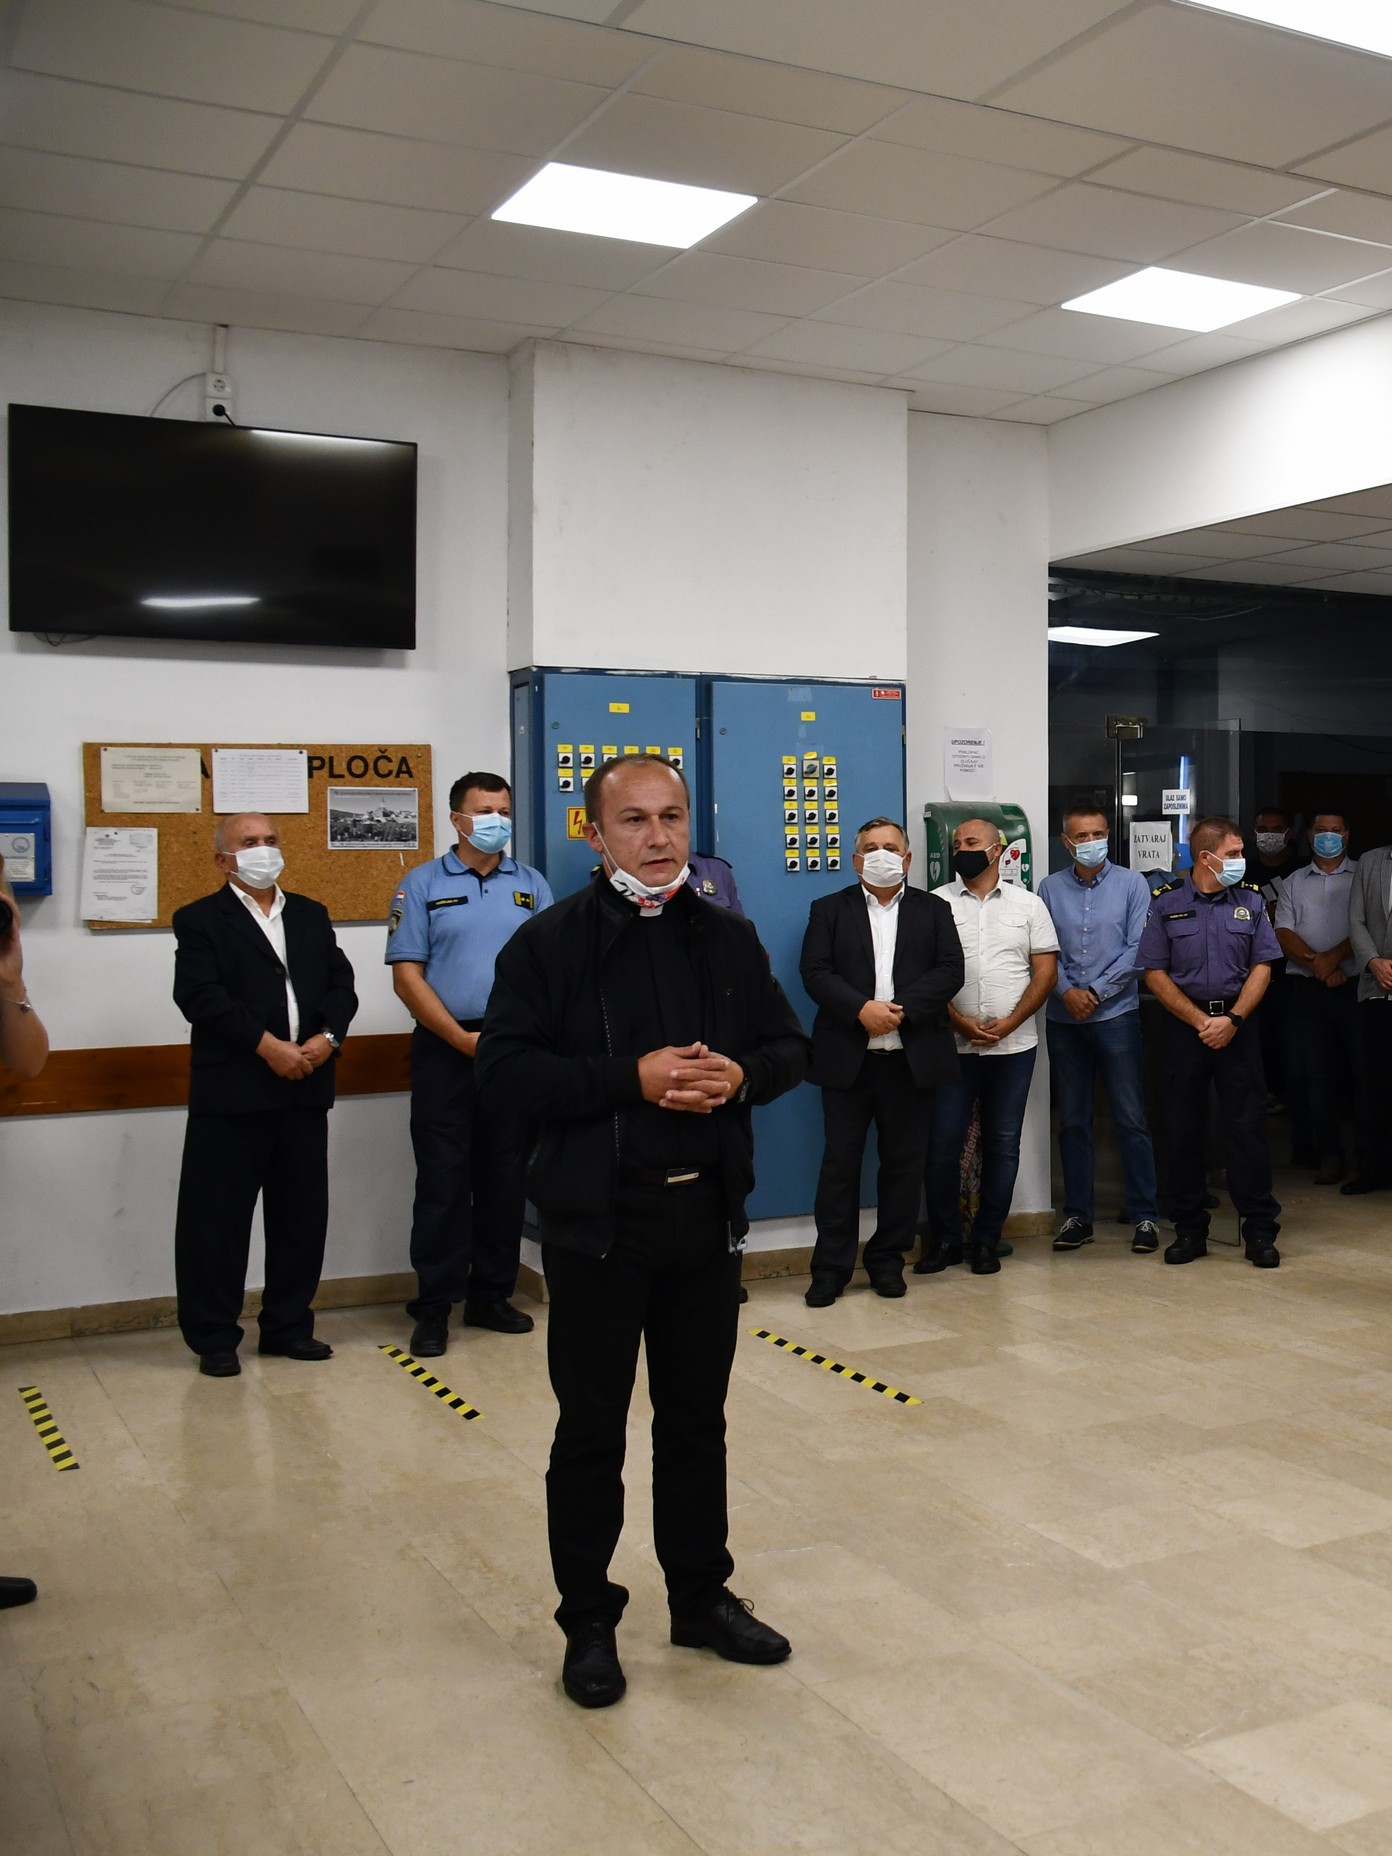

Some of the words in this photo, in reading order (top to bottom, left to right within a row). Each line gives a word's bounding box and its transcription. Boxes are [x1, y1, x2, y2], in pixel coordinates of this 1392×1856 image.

[307, 748, 414, 779] PLOČA
[1133, 834, 1167, 843] ZATVARAJ
[1138, 850, 1160, 858] VRATA
